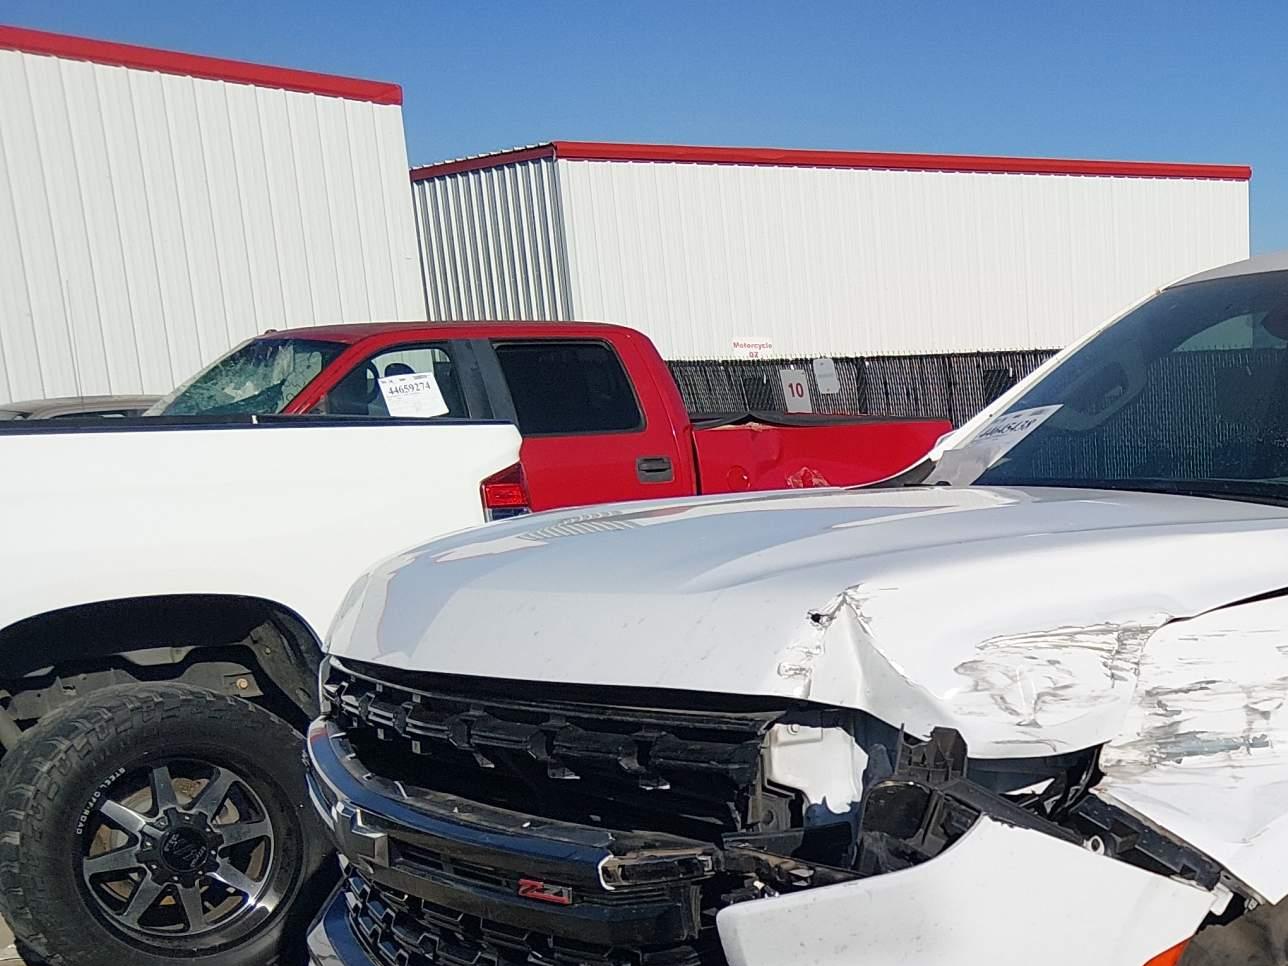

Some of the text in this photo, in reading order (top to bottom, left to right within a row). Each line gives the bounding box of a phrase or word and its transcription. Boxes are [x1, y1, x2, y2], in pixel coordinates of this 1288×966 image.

[732, 342, 773, 351] Motorcycle
[388, 381, 431, 396] 44659274
[788, 382, 804, 398] 10
[517, 878, 573, 905] Z71
